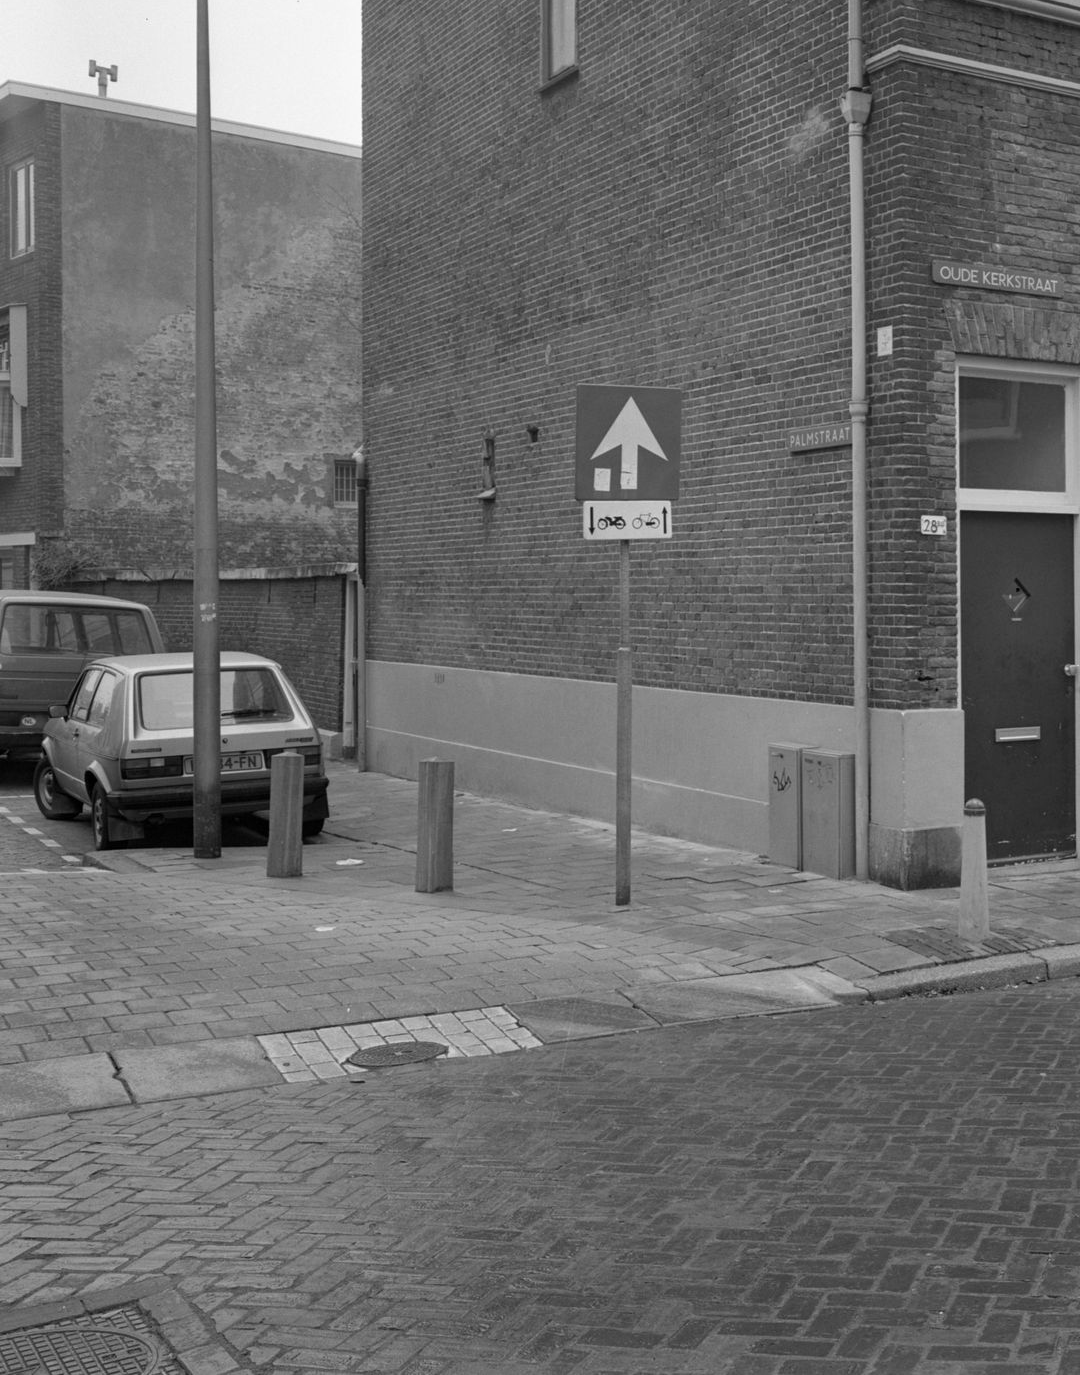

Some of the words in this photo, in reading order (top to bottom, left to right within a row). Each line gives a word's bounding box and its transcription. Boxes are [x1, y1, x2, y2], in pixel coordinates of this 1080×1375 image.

[940, 266, 979, 283] OUDE
[982, 271, 1058, 293] KERKSTRAAT
[790, 427, 850, 448] PALMSTRAAT
